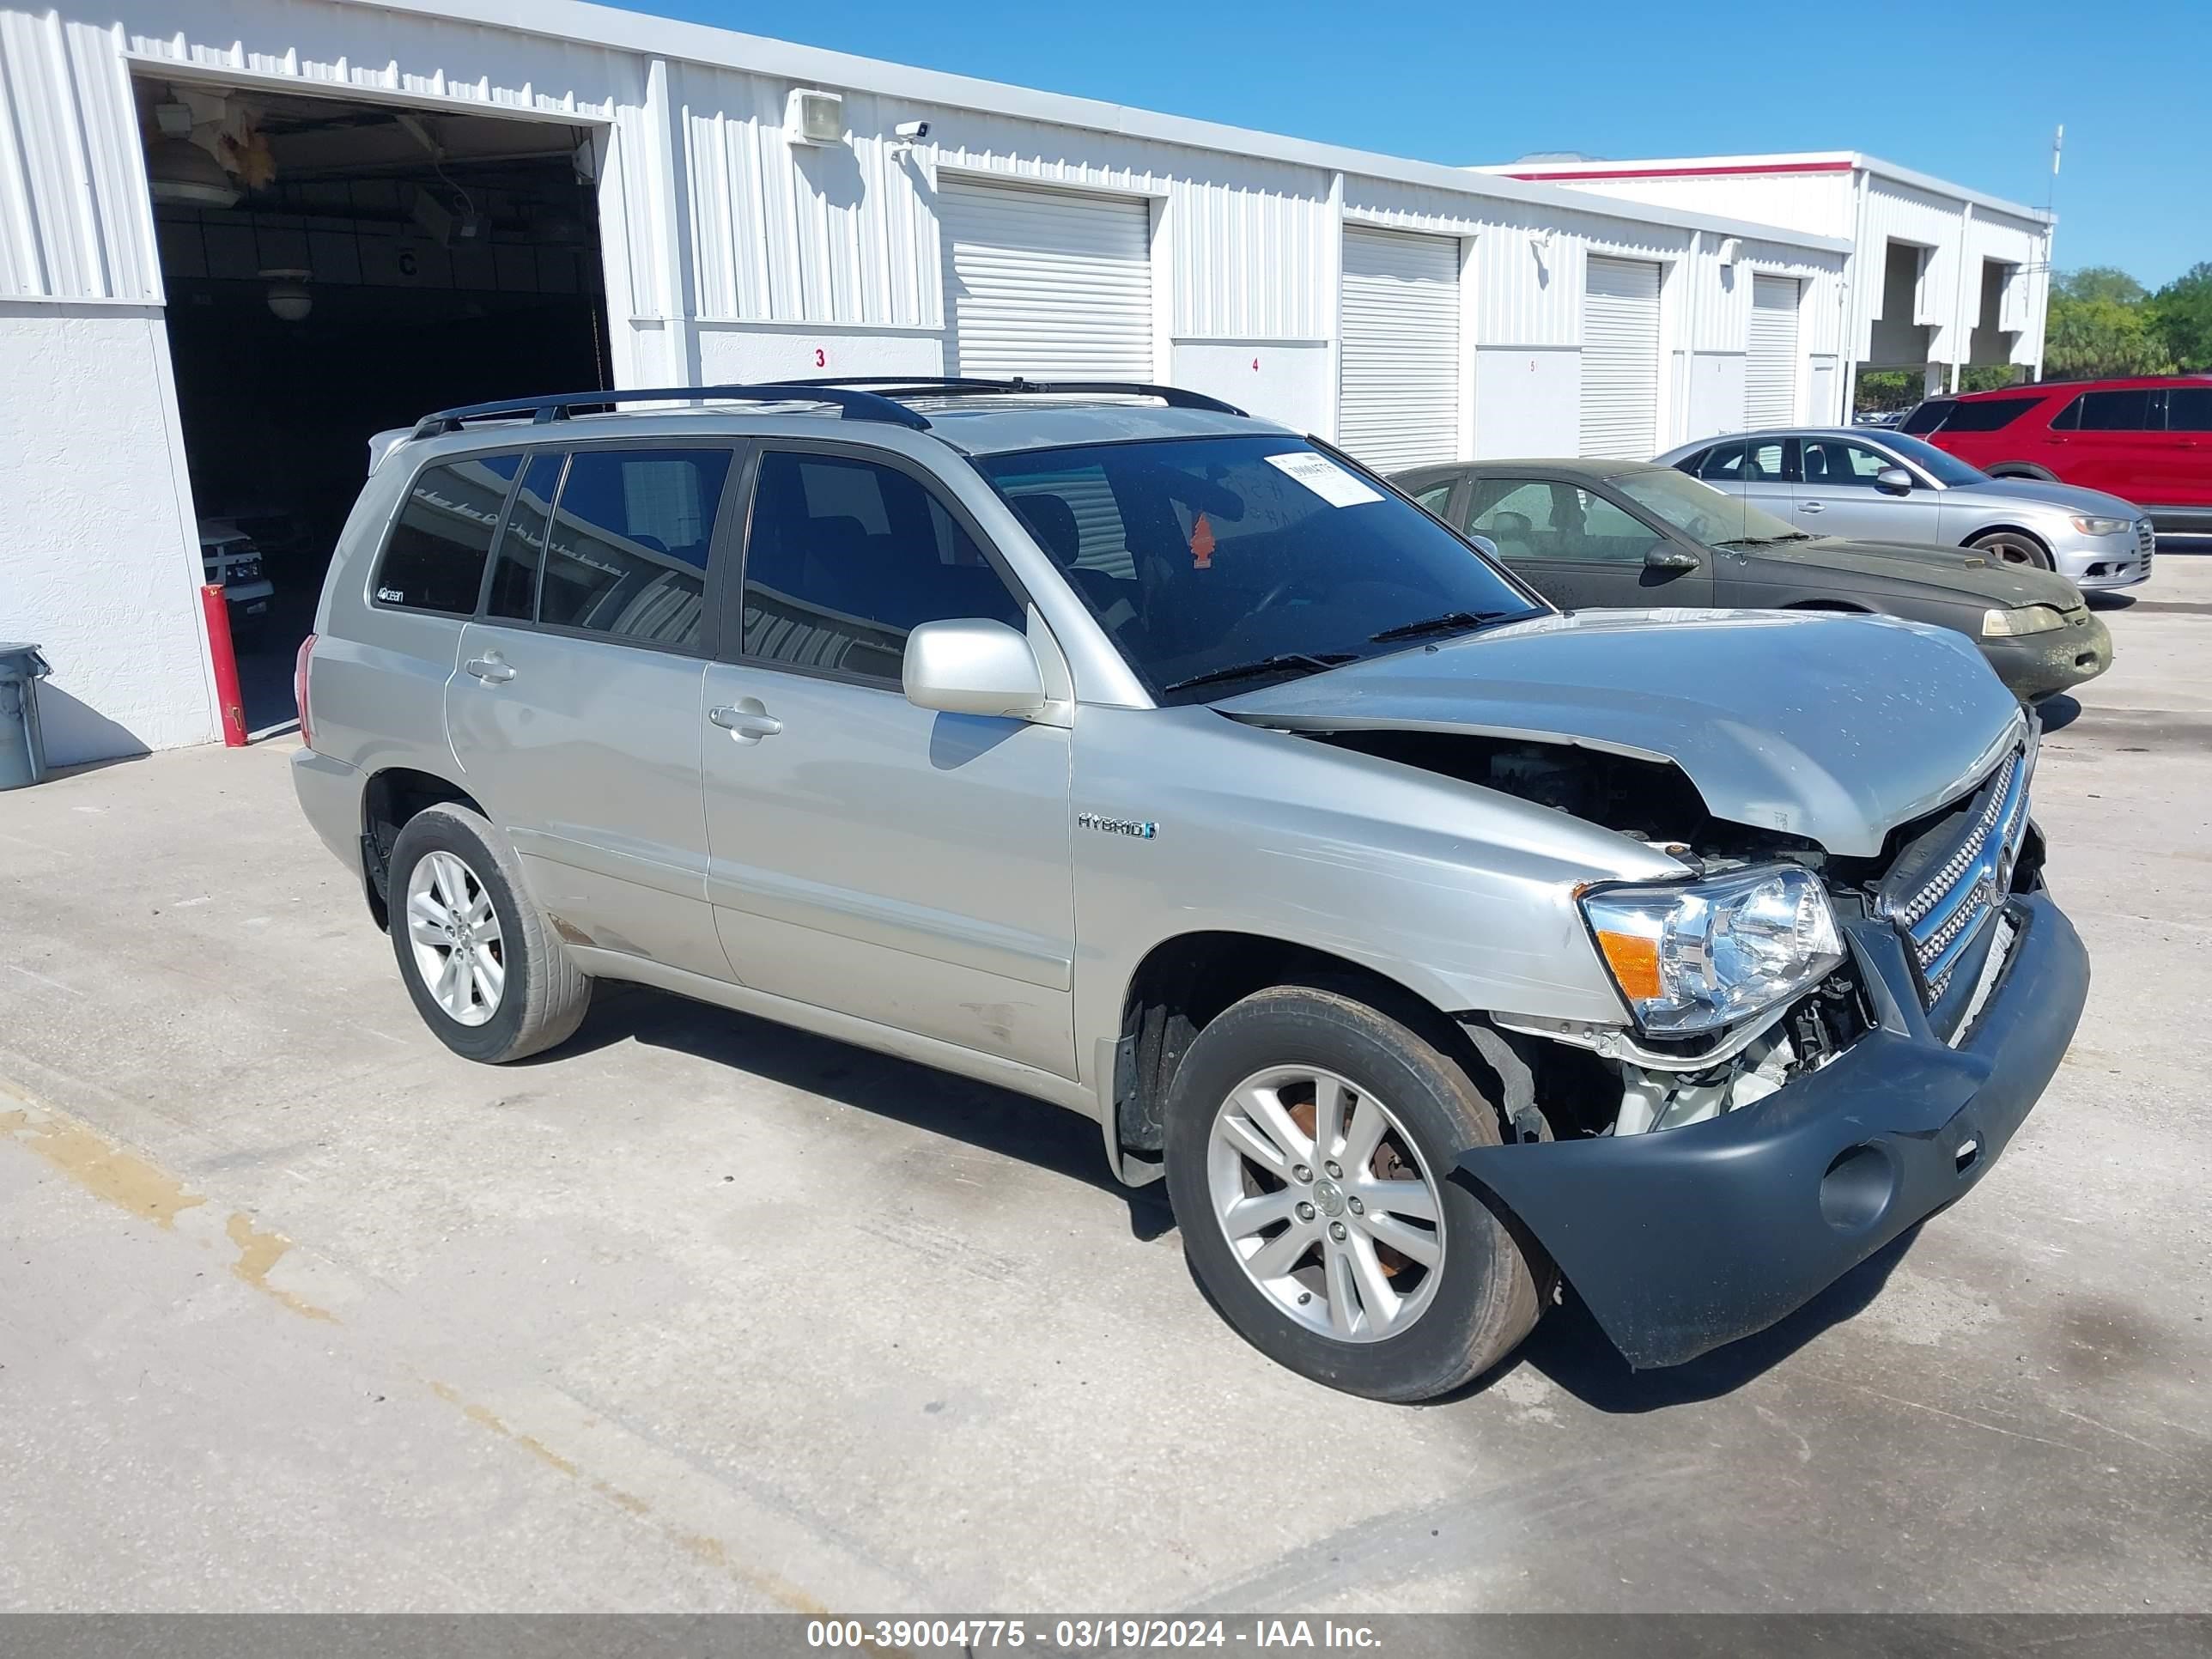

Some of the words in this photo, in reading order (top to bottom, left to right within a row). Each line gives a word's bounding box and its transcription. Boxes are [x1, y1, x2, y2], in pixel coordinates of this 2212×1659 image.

[398, 253, 417, 276] C
[816, 349, 825, 368] 3
[1252, 356, 1259, 373] 4
[1079, 812, 1143, 837] HYBRID
